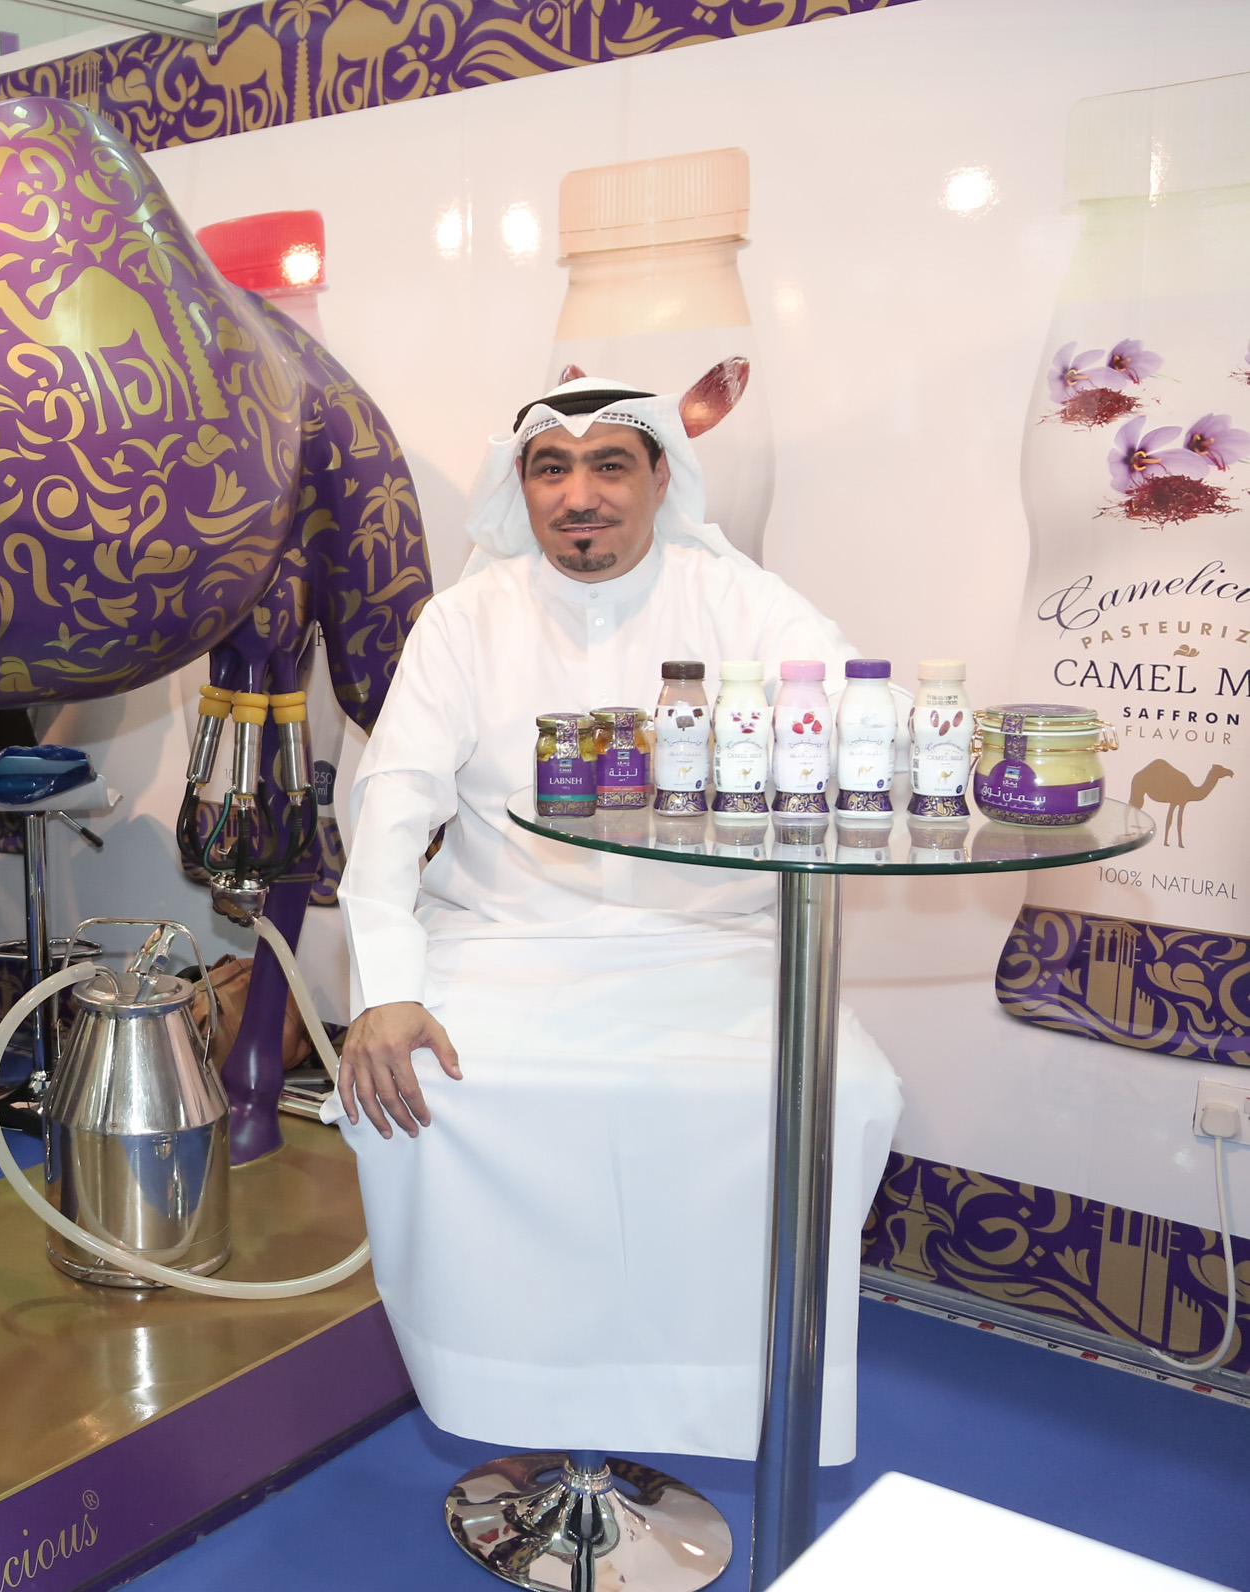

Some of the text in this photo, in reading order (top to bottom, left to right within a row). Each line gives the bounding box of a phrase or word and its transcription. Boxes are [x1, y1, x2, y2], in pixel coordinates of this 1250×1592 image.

[1081, 620, 1250, 649] PASTEURIZ
[1054, 658, 1198, 694] CAMEL
[1123, 706, 1240, 726] SAFFRON
[1125, 725, 1231, 745] FLAVOUR
[314, 772, 333, 784] 250
[549, 777, 583, 785] LABNEH
[608, 767, 638, 780] لبنة
[317, 785, 328, 796] ml
[1097, 865, 1238, 900] 100% NATURAL
